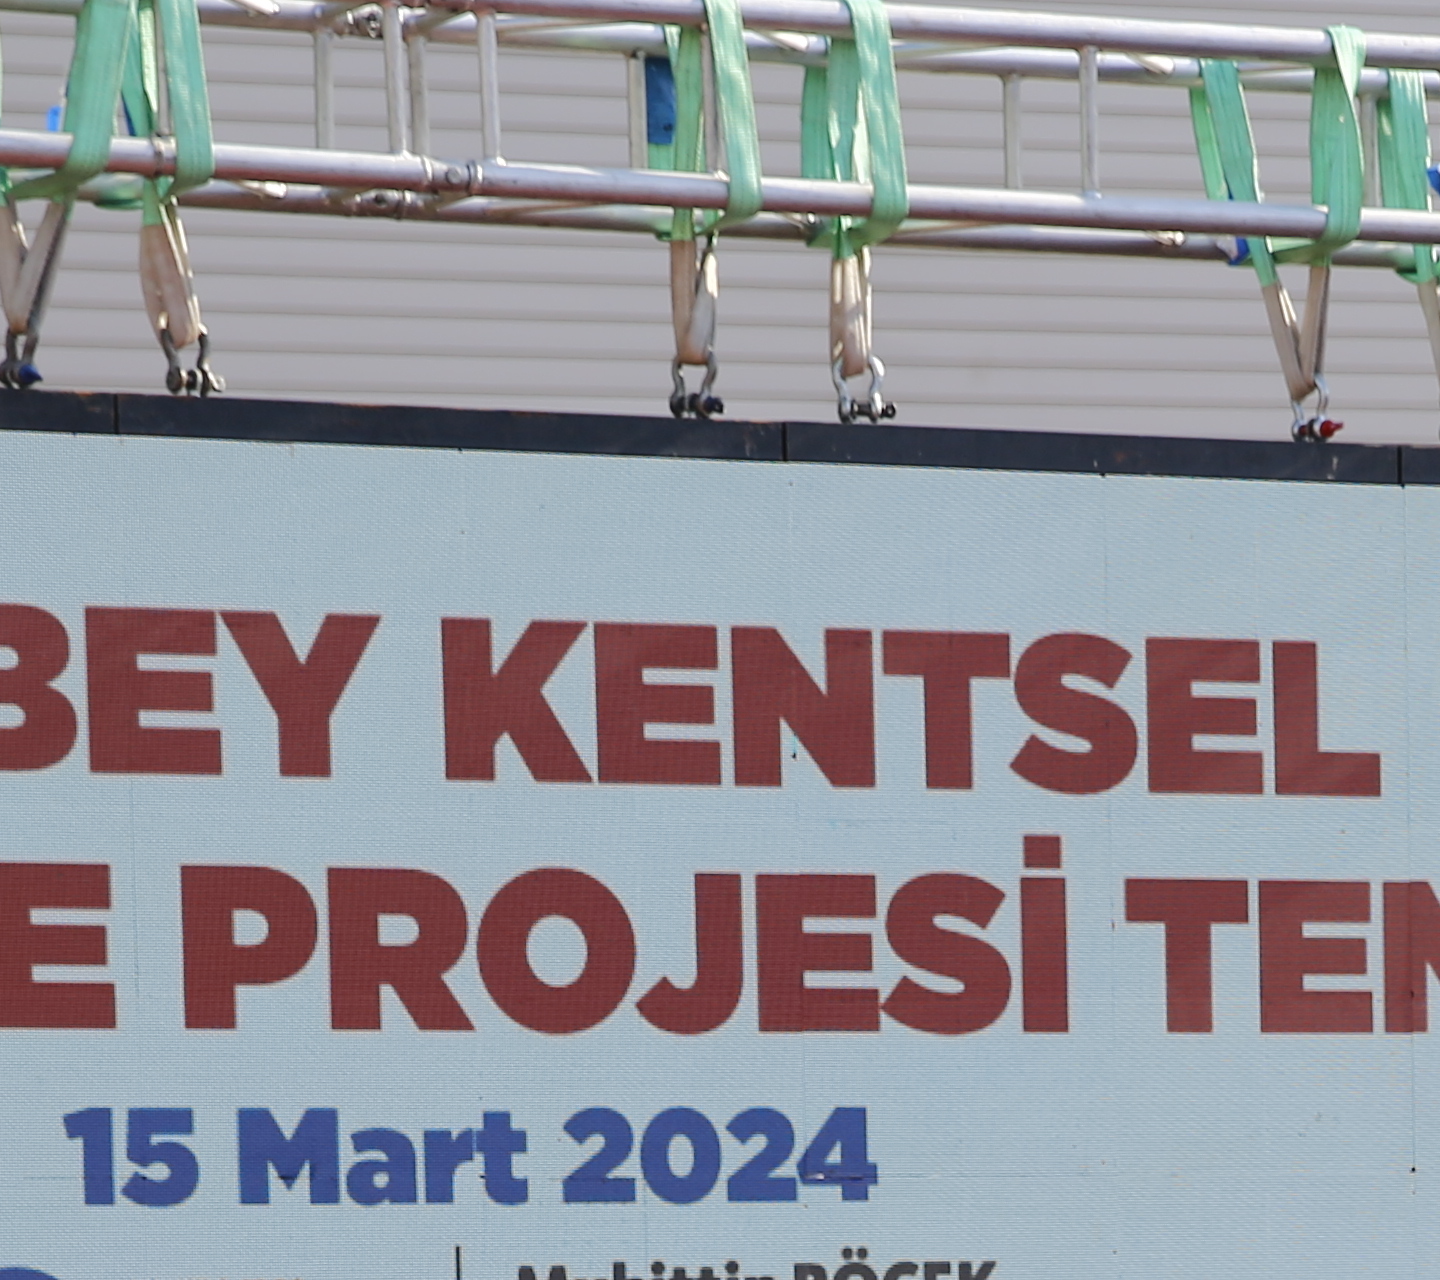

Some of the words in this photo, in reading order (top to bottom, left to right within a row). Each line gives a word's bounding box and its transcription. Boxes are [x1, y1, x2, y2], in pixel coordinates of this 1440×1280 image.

[440, 615, 1382, 797] KENTSEL
[181, 832, 1070, 1037] PROJESİ
[63, 1106, 200, 1207] 15
[238, 1107, 528, 1206] Mart
[562, 1106, 878, 1204] 2024
